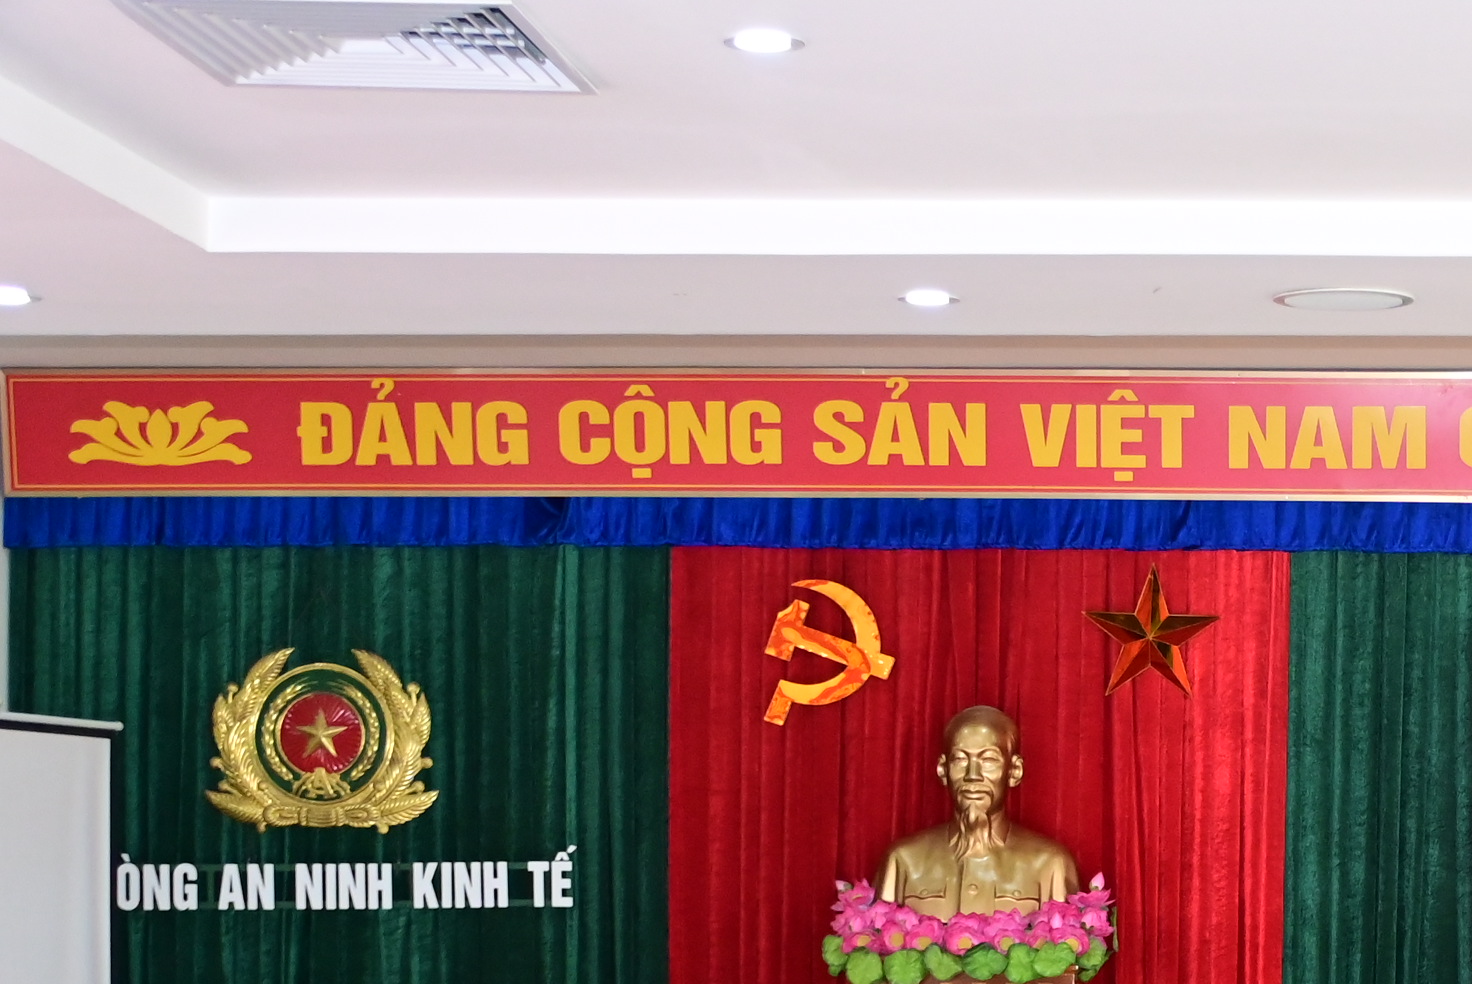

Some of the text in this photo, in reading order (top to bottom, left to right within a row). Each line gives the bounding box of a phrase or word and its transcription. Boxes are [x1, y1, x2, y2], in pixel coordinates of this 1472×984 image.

[297, 378, 530, 465] ĐẢNG
[558, 384, 783, 479] CỘNG
[812, 377, 988, 467] SẢN
[1020, 389, 1194, 481] VIỆT
[1229, 405, 1428, 469] NAM
[219, 864, 274, 909] AN
[296, 863, 392, 909] NINH
[413, 862, 508, 908] KINH
[528, 845, 577, 908] TẾ
